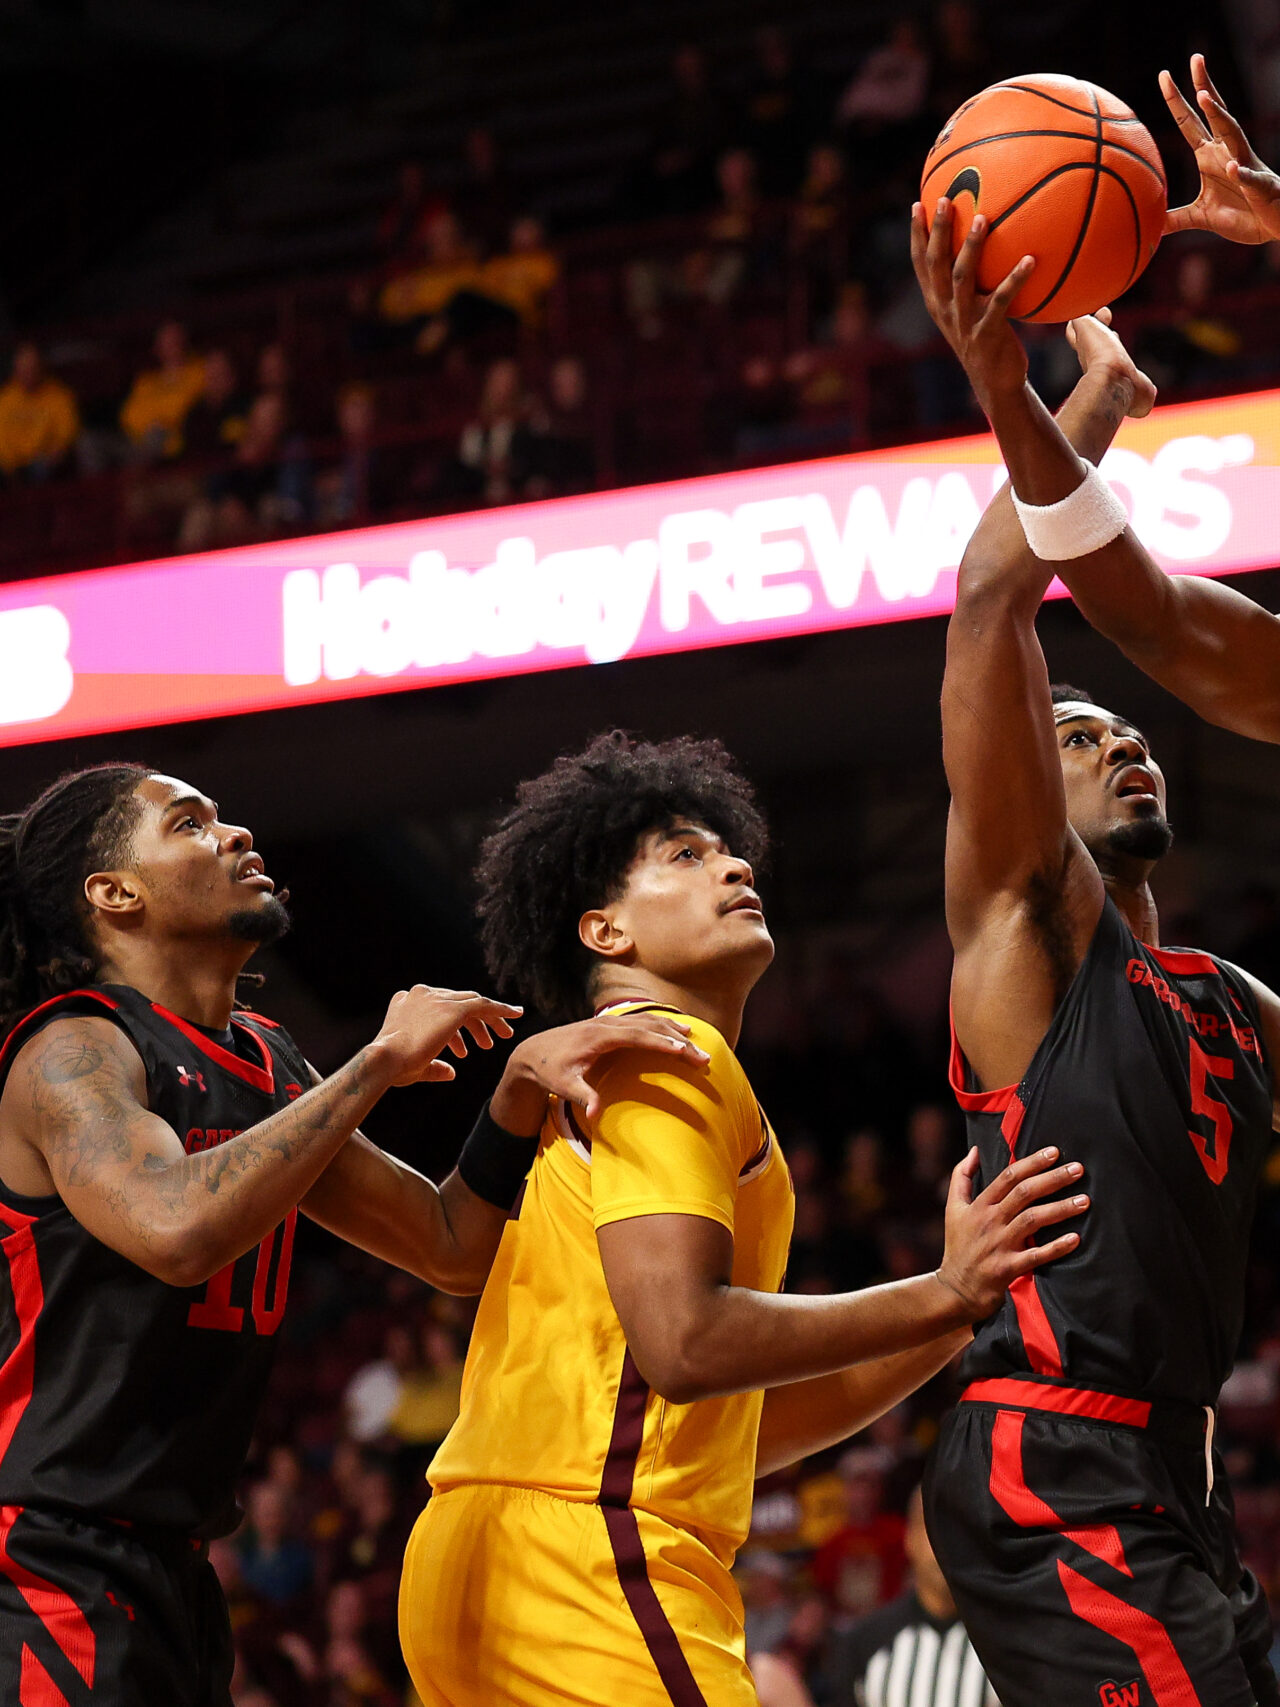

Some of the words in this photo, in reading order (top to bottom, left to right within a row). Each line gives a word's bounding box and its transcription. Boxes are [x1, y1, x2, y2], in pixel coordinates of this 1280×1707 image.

[1188, 1036, 1233, 1186] 5
[187, 1204, 298, 1336] 10
[1099, 1681, 1140, 1707] GW
